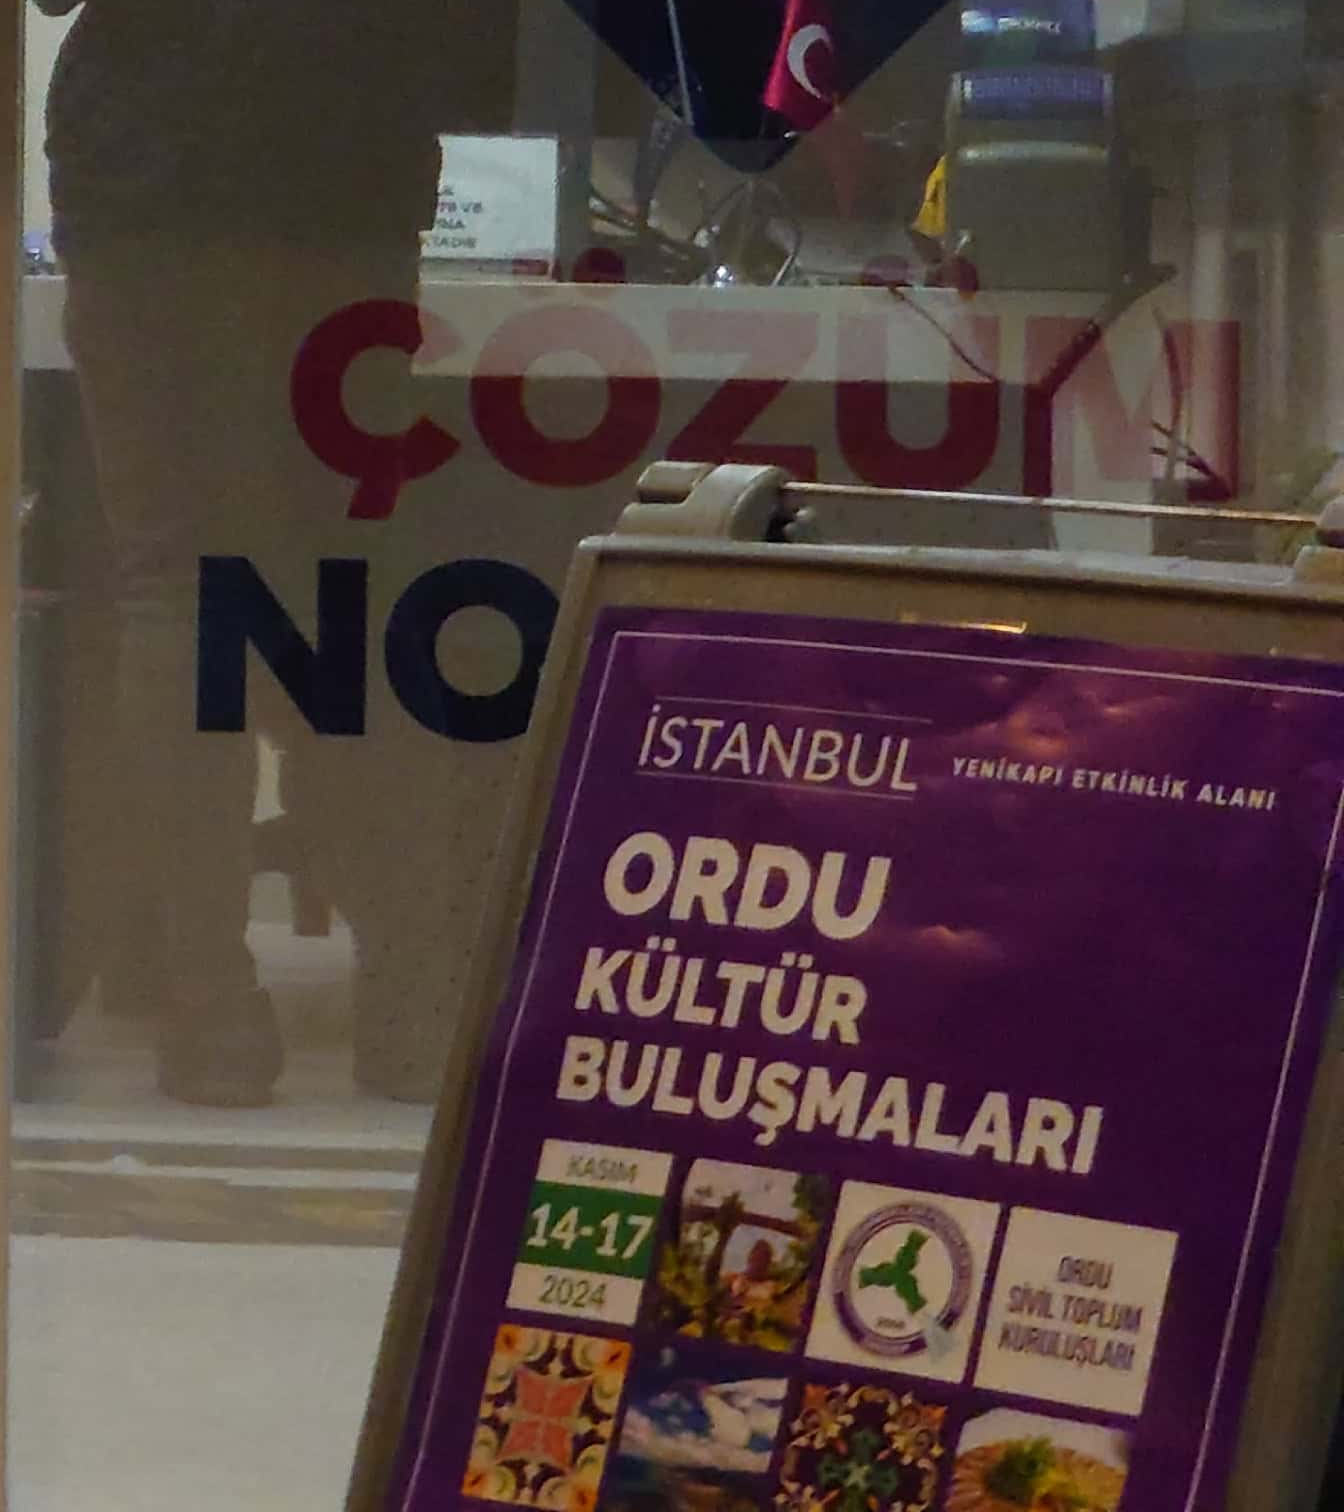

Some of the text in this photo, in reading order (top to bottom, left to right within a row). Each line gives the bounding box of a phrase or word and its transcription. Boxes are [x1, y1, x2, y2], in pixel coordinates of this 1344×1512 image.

[288, 246, 1241, 521] ÇÖZÜM
[638, 705, 1277, 812] İSTANBUL YENİKAPI ETKİNLİK ALANI
[603, 831, 892, 942] ORDU
[574, 936, 868, 1046] KÜLTÜR
[556, 1035, 1105, 1177] BULUŞMALARI
[525, 1201, 656, 1260] 14-17
[1057, 1255, 1114, 1289] ORDU
[538, 1273, 608, 1309] 2024
[1061, 1294, 1144, 1333] TOPLUM
